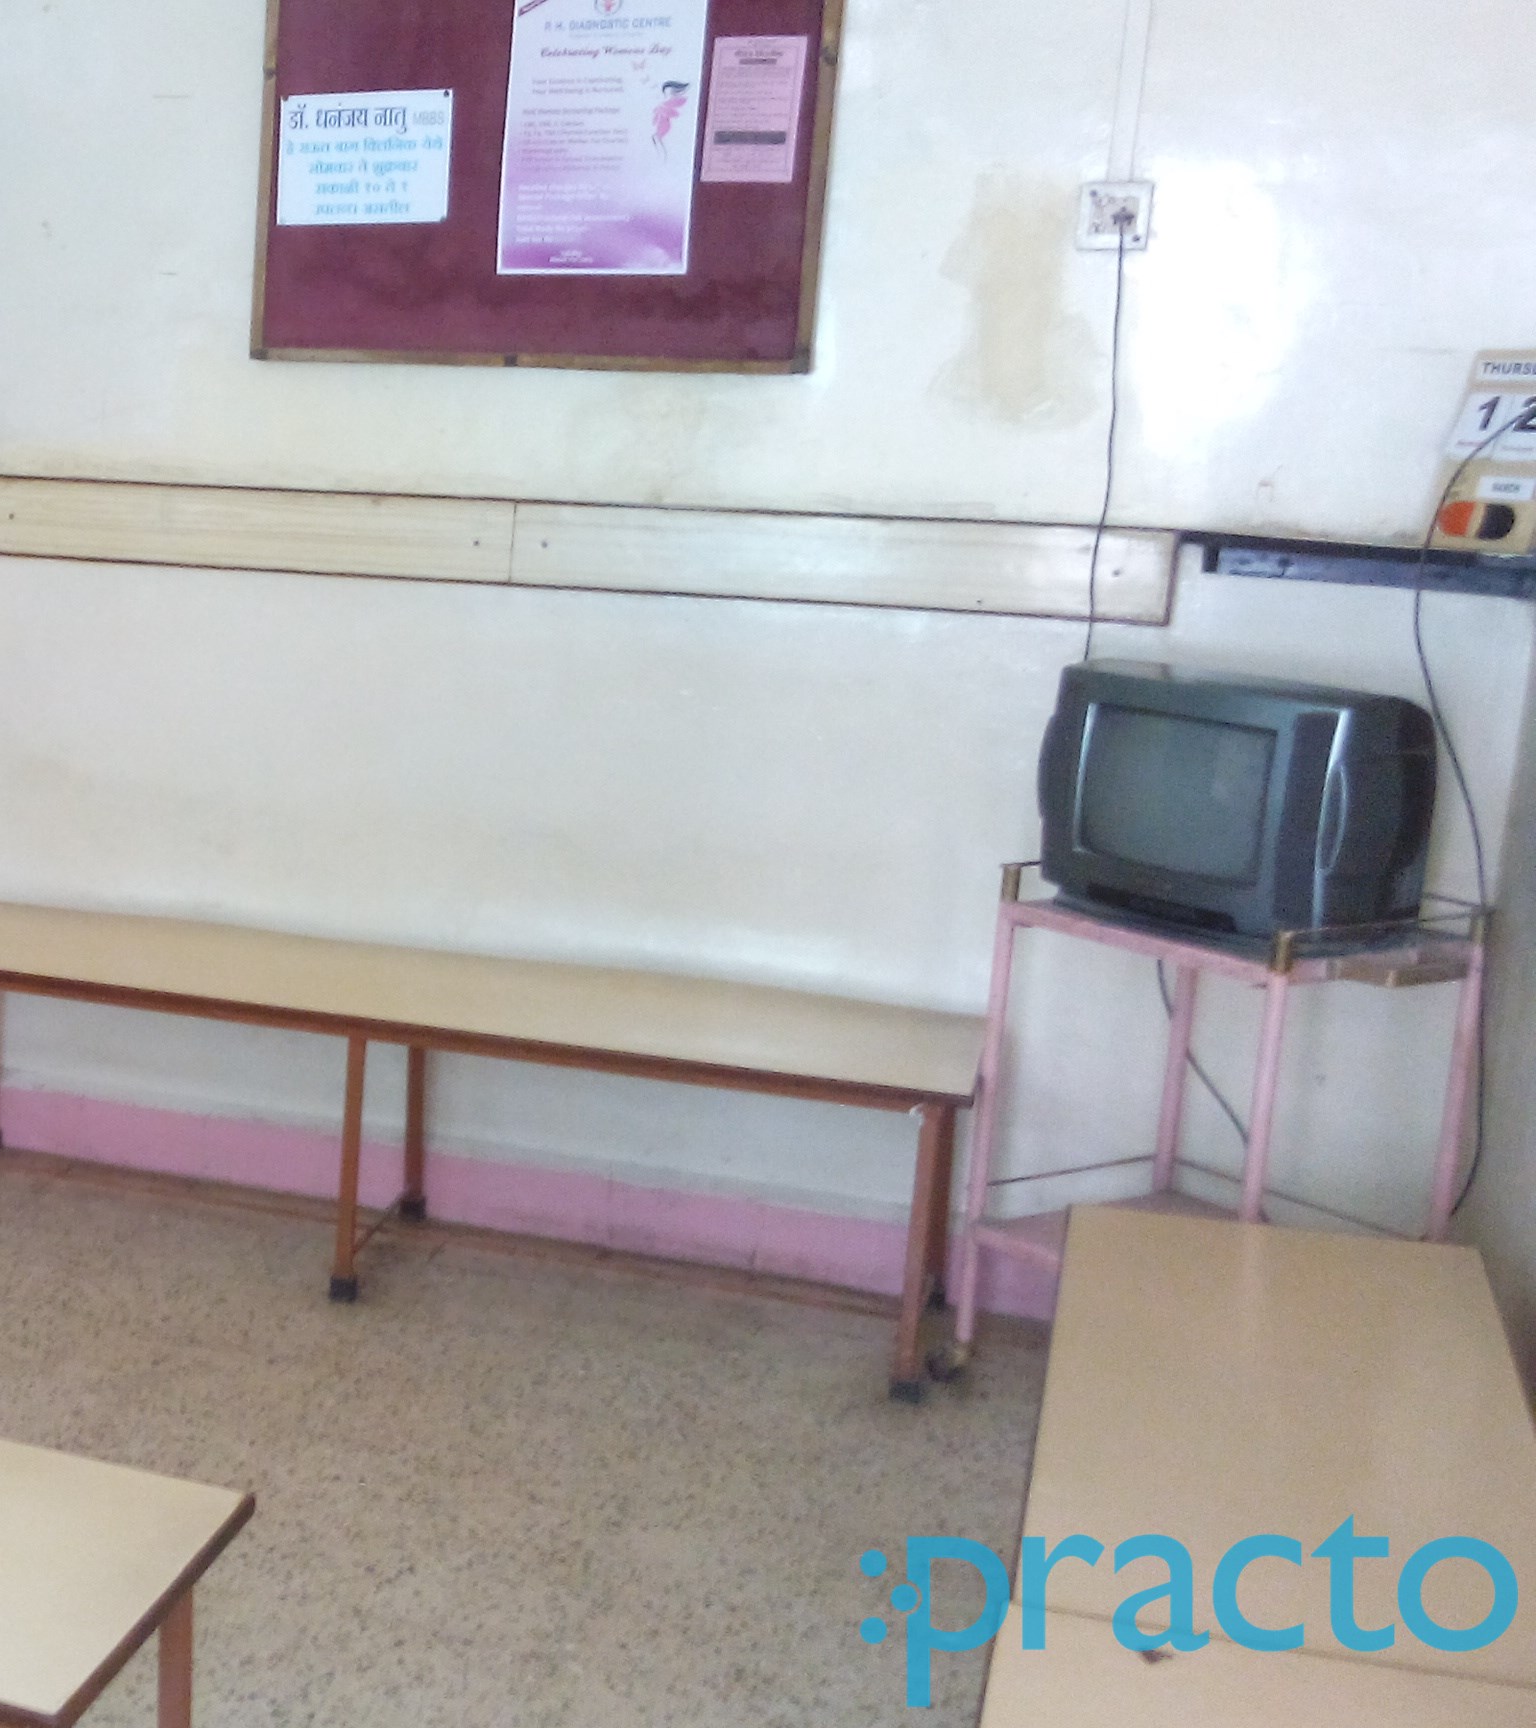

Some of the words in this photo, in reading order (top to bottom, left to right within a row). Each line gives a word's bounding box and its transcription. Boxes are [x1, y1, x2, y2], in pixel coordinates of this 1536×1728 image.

[569, 17, 630, 31] DIAGNOSTIC
[631, 15, 672, 28] CENTRE
[289, 103, 309, 129] डॉ.
[315, 102, 368, 129] धनंजय
[374, 106, 407, 134] नातु
[413, 111, 444, 125] MBBS
[1483, 362, 1536, 375] THURS
